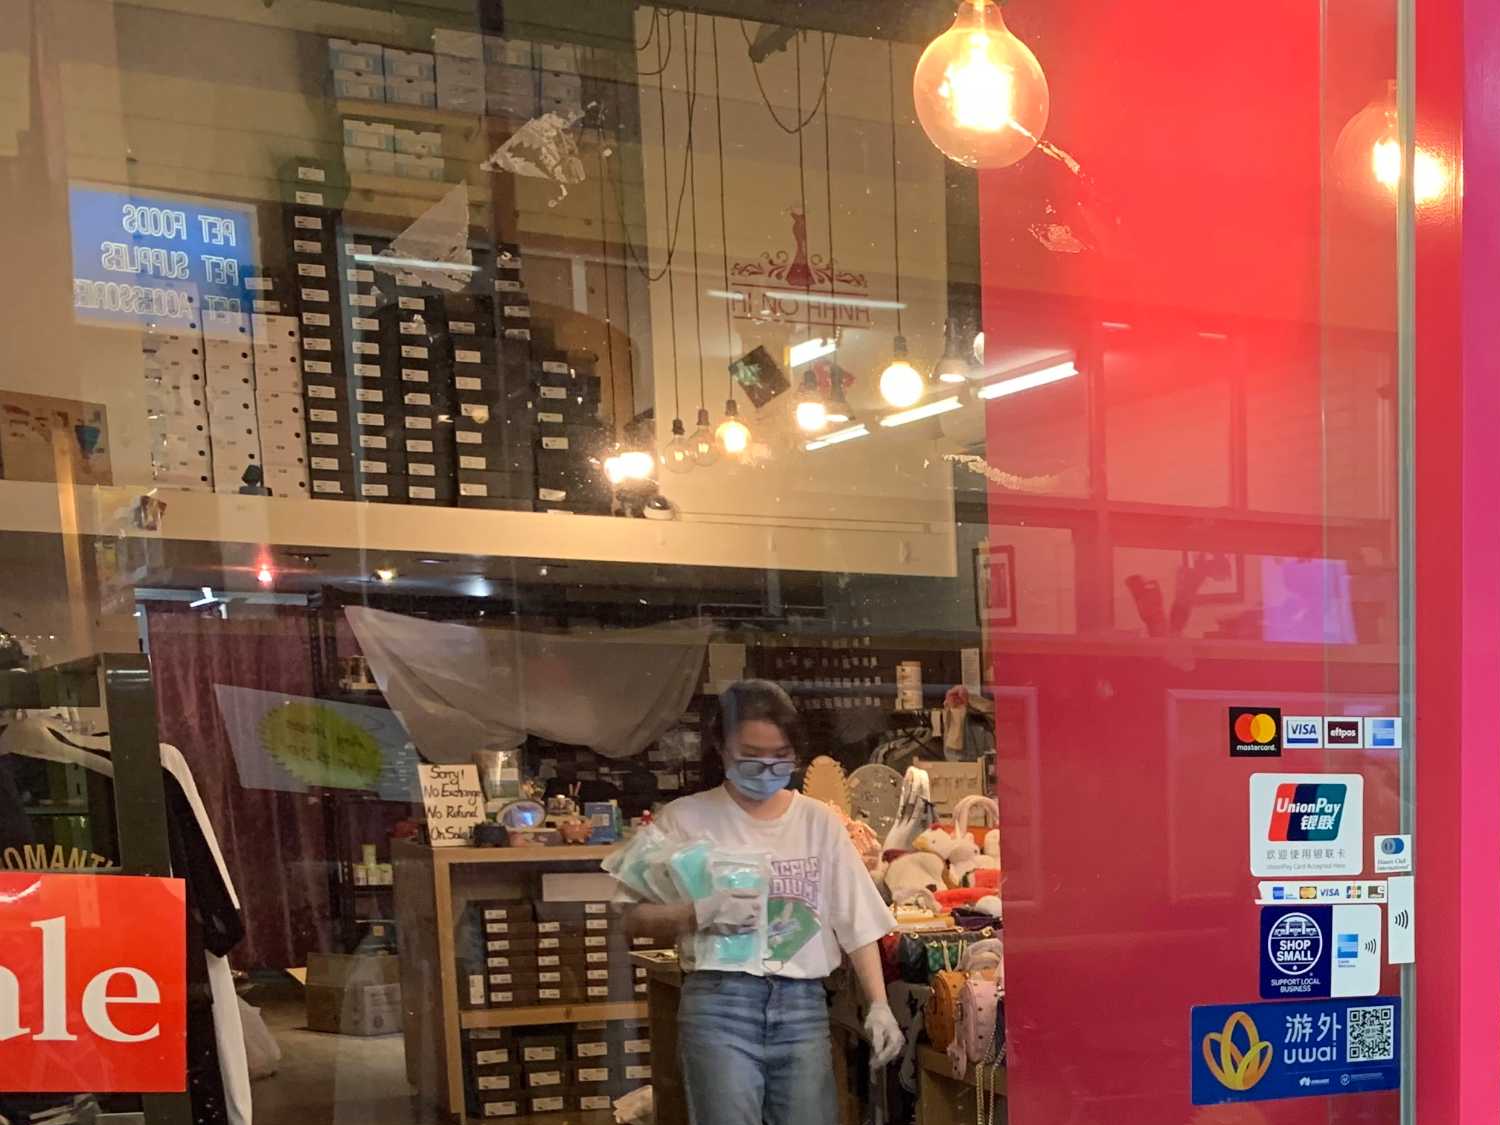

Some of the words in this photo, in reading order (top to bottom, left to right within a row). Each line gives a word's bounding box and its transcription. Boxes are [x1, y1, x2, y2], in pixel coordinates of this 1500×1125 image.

[1291, 723, 1317, 736] VISA
[1330, 727, 1356, 739] eftpos
[1276, 797, 1341, 816] UnionPay
[0, 844, 113, 869] OMANT
[1320, 888, 1340, 897] VISA
[1280, 940, 1311, 950] SHOP
[1277, 951, 1314, 962] SMALL
[1271, 978, 1300, 986] SUPPORT
[1301, 977, 1320, 985] LOCAL
[1280, 985, 1311, 993] BUSINESS
[1284, 1013, 1342, 1043] 游外
[1283, 1043, 1337, 1064] uwai
